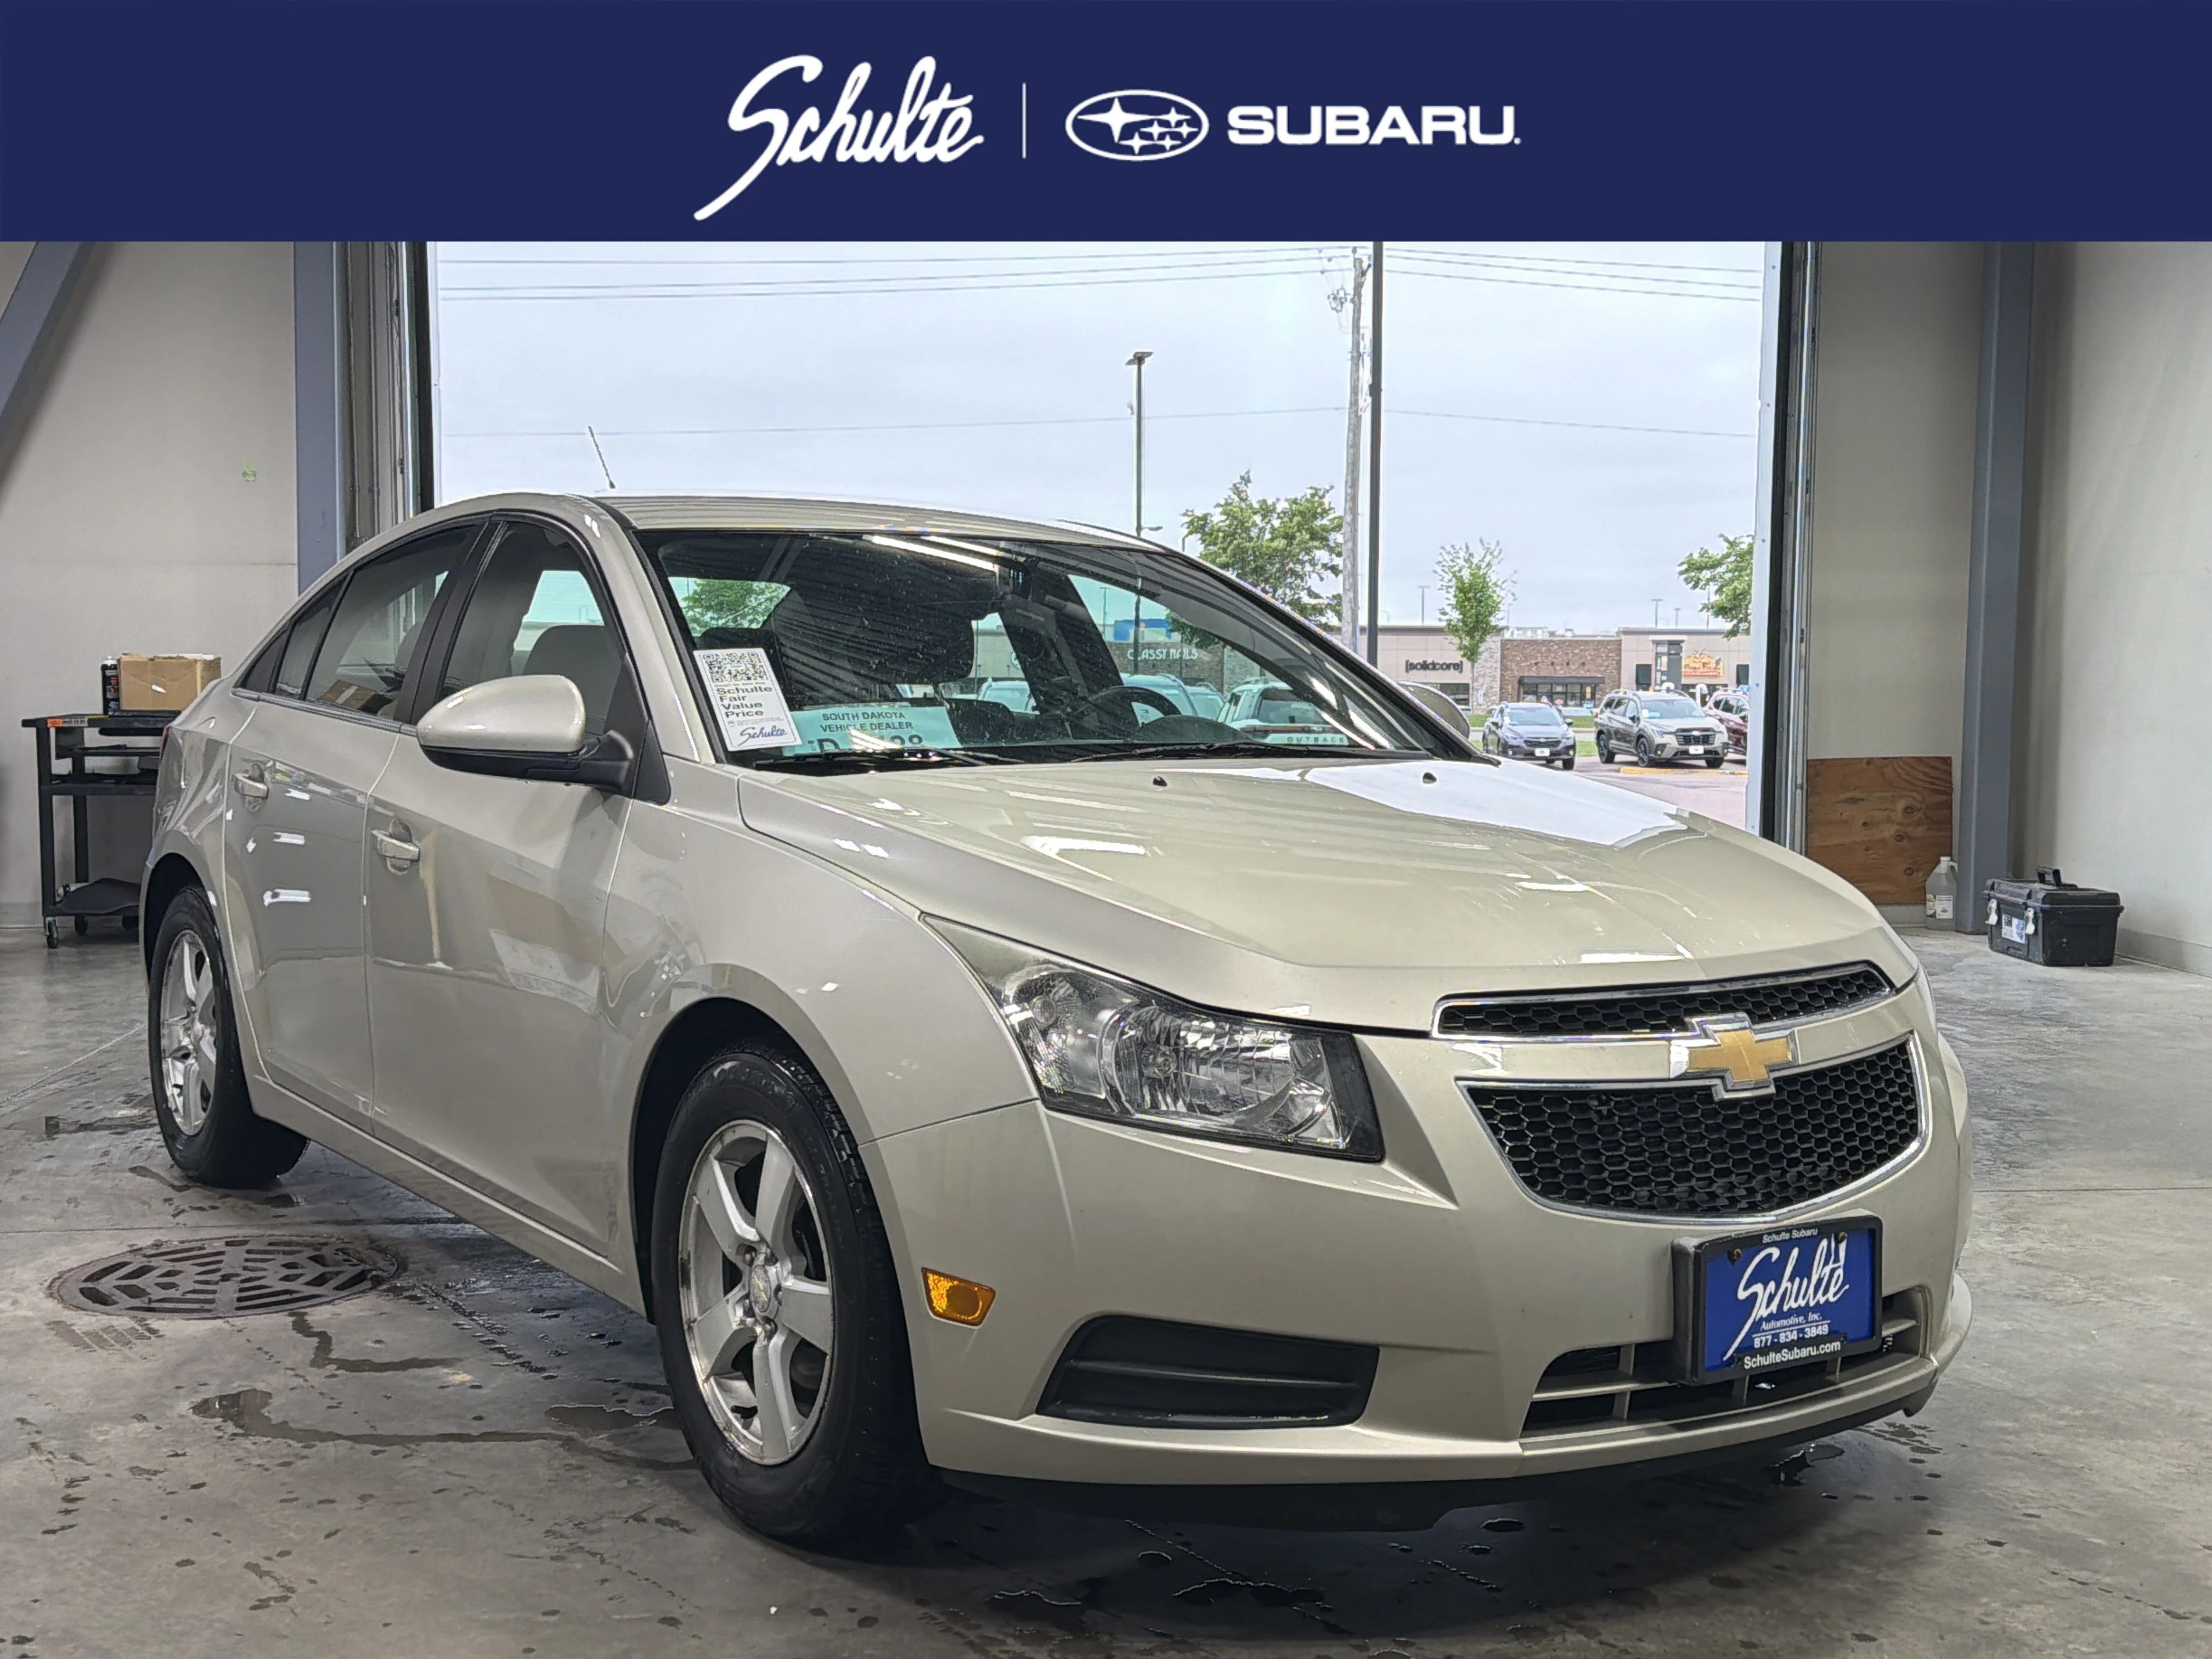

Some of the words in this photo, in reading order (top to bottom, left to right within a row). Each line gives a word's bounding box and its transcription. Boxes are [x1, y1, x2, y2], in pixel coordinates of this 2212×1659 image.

[716, 686, 772, 695] Schulte
[822, 713, 859, 721] SOUTH
[862, 712, 906, 720] DAKOTA
[870, 721, 913, 731] DEALER
[737, 725, 787, 747] Schulte
[1762, 1232, 1790, 1243] Schulte
[1791, 1228, 1818, 1239] Subaru
[1744, 1341, 1841, 1369] SchulteSubaru.com
